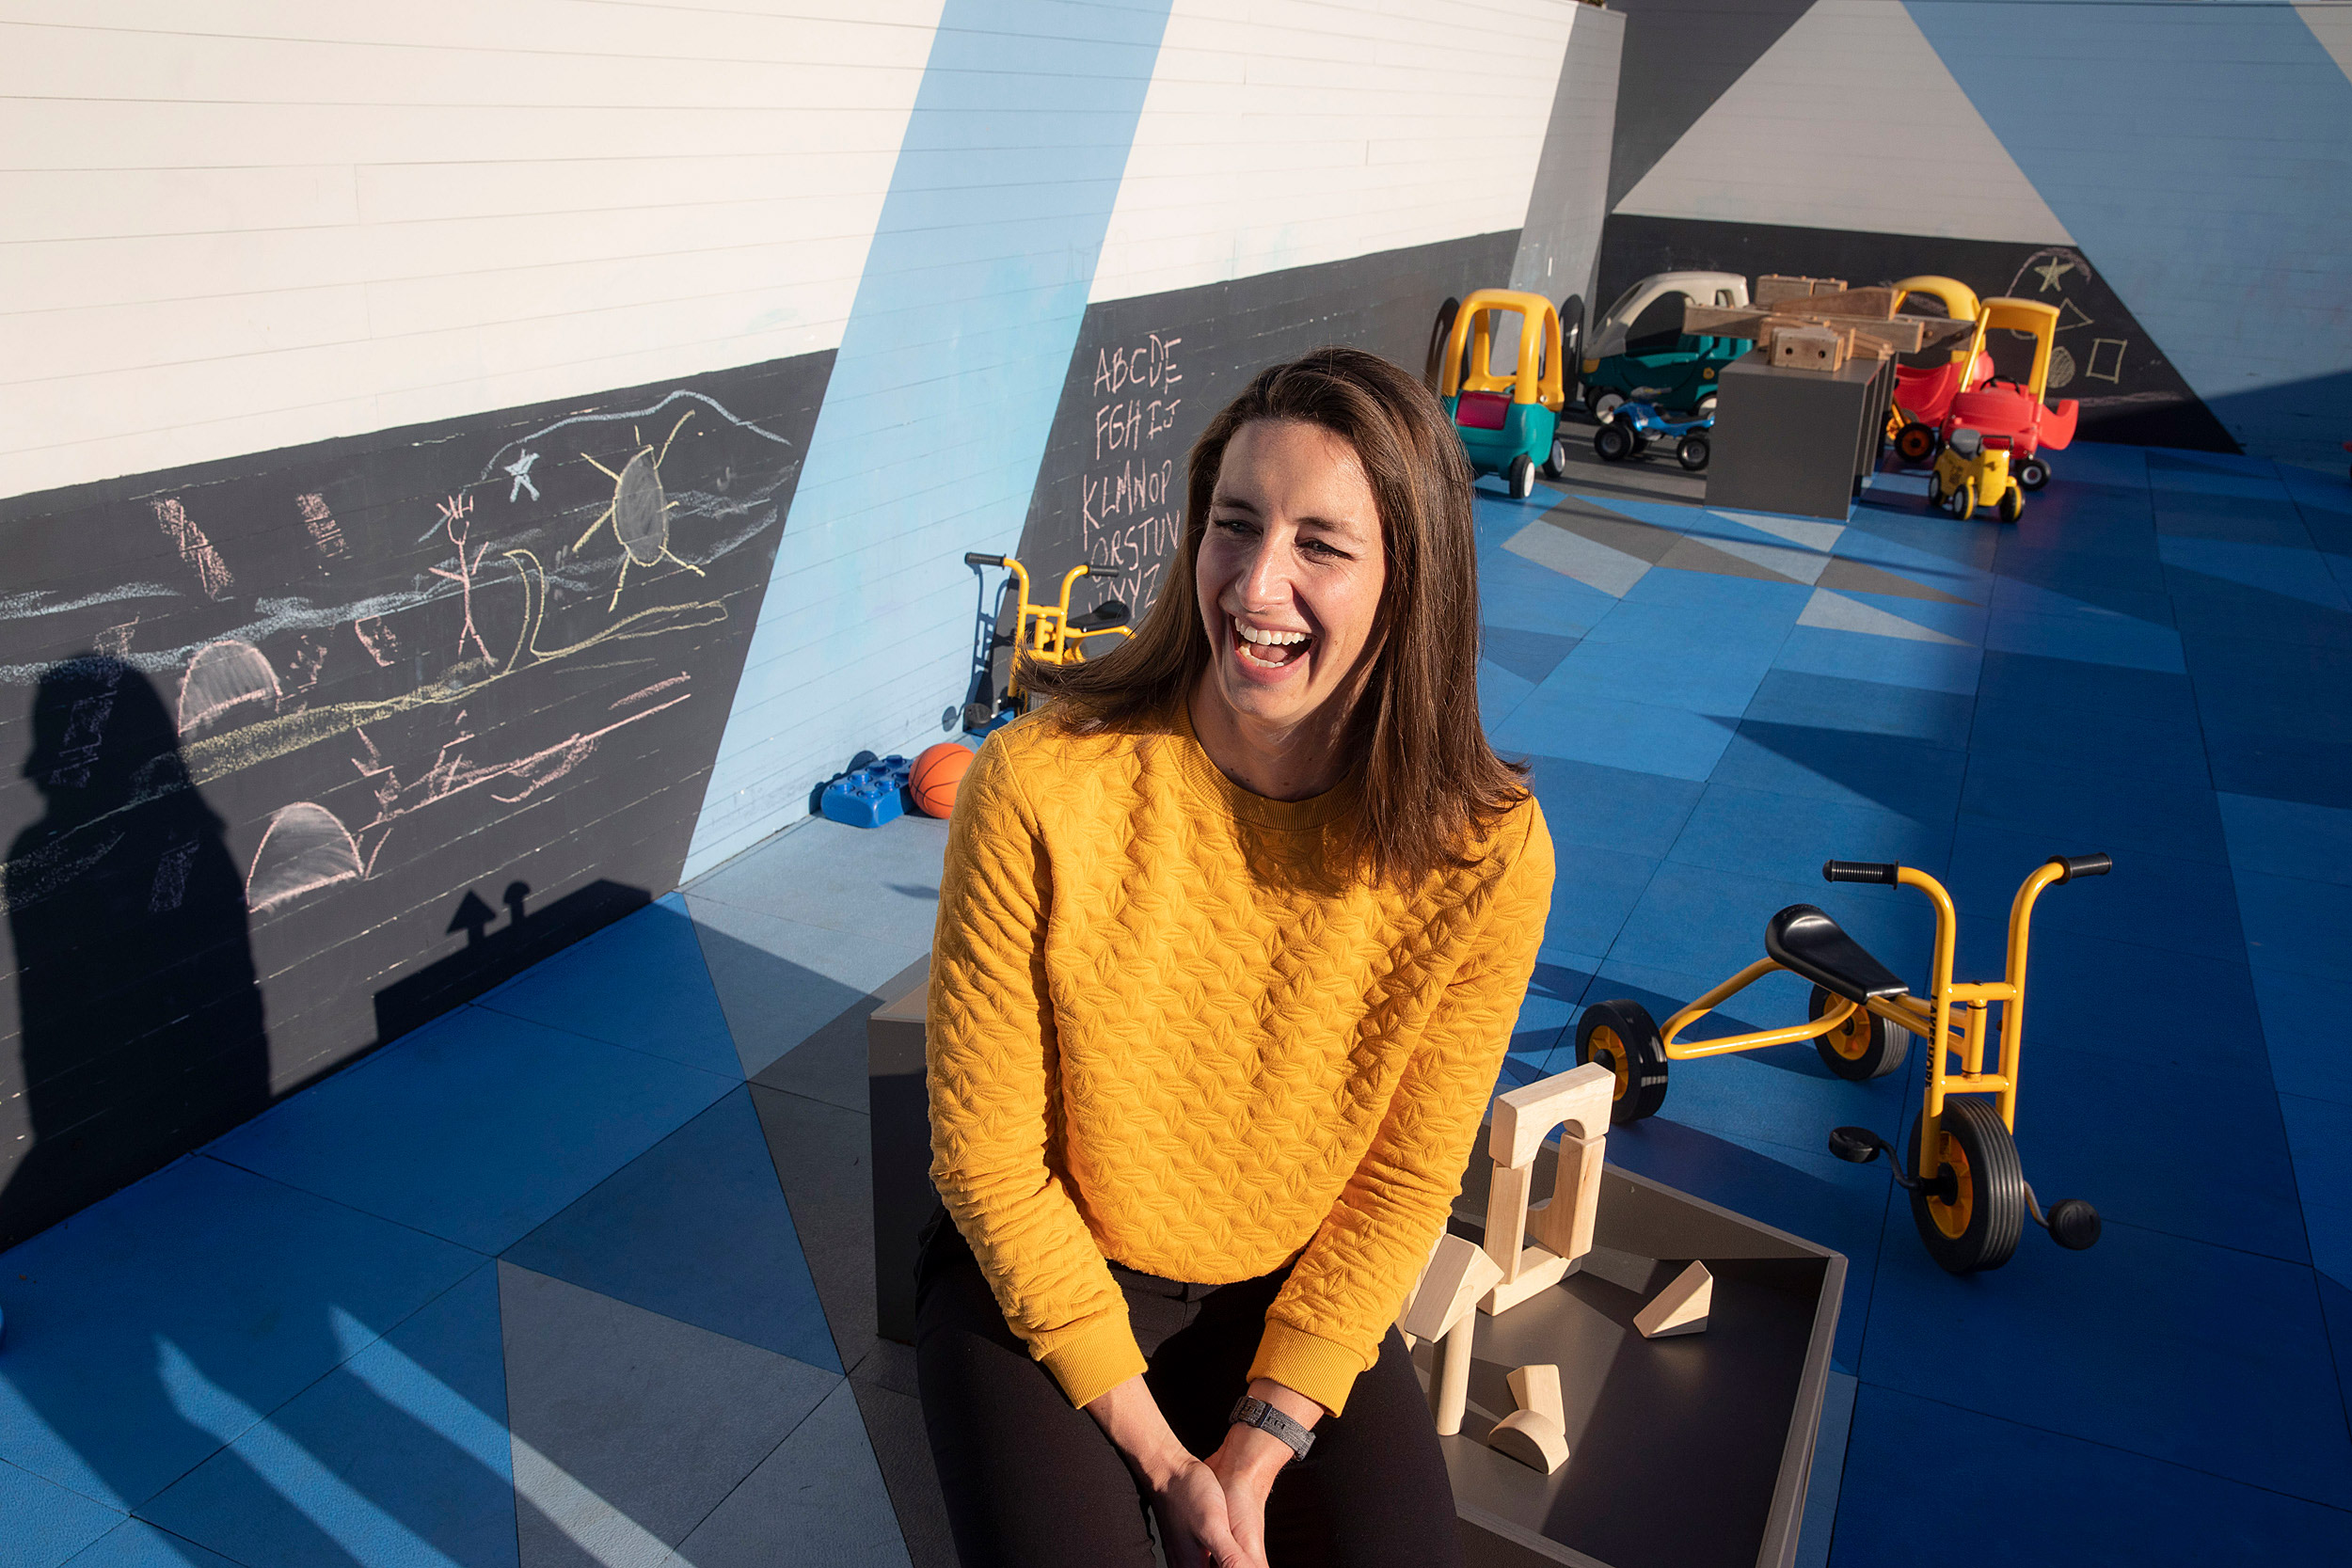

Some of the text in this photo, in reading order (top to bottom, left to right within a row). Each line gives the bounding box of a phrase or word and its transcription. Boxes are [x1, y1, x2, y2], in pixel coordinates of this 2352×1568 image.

[1094, 334, 1183, 396] ABCDE
[1096, 399, 1181, 460] FGHIJ
[1083, 458, 1172, 552] KLMNOP
